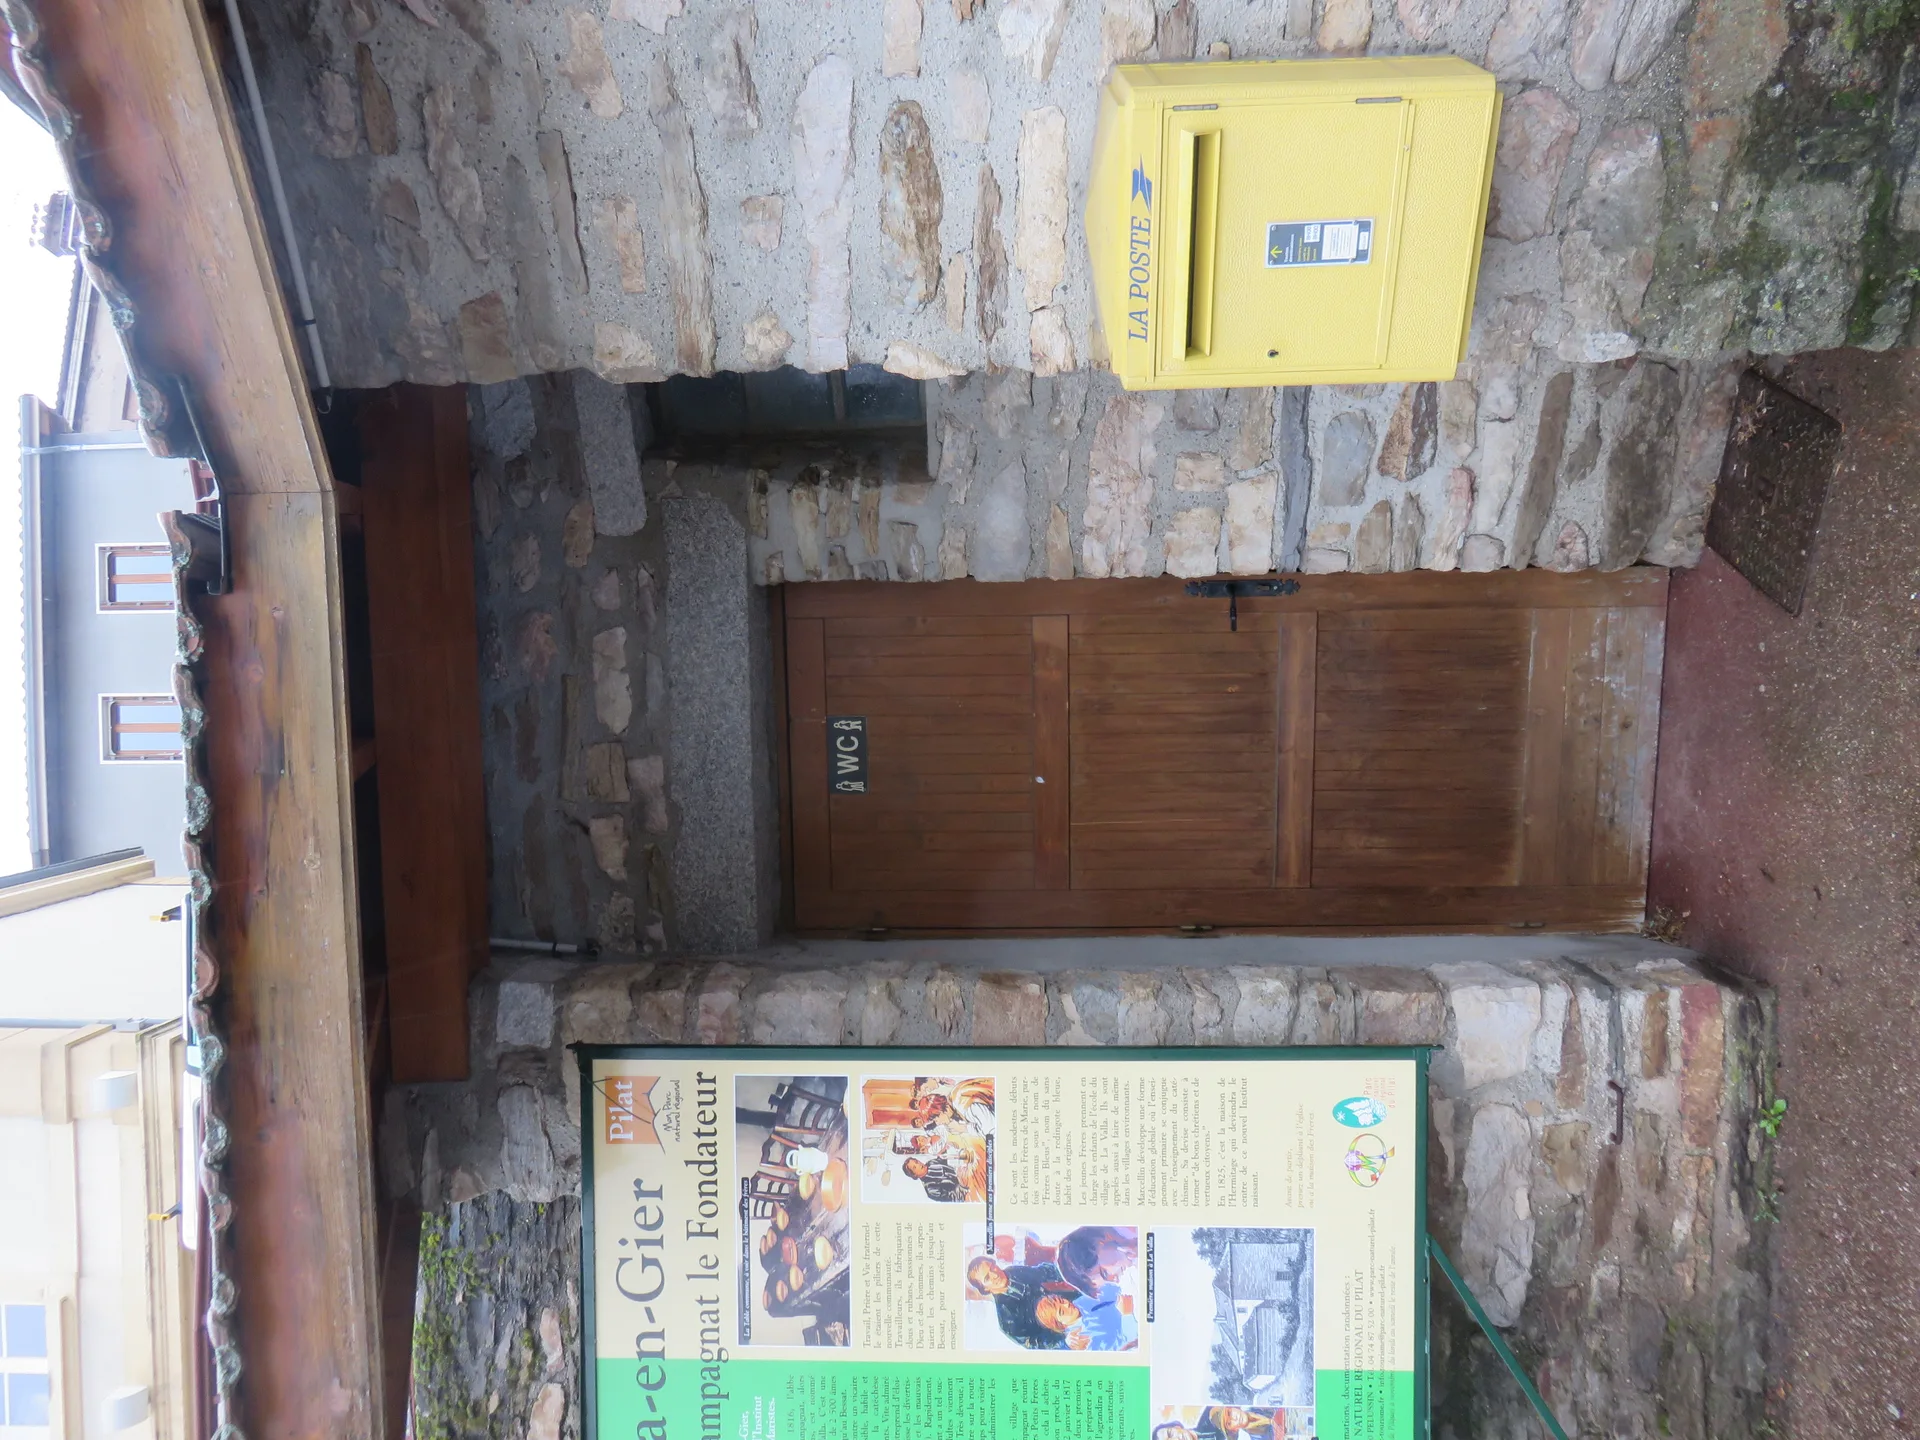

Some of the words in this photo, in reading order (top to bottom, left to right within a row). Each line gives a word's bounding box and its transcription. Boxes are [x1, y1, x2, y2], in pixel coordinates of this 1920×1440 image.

[1129, 216, 1151, 301] POSTE
[1128, 308, 1149, 343] LA
[837, 736, 859, 774] WC
[662, 1091, 672, 1110] Parc
[670, 1080, 683, 1110] régional
[1009, 1076, 1017, 1103] débuts
[1053, 1077, 1061, 1102] bleue,
[1089, 1091, 1097, 1117] l'école
[1137, 1077, 1145, 1101] forme
[1148, 1077, 1156, 1107] l'ensei-
[1160, 1077, 1168, 1115] conjugue
[1239, 1078, 1247, 1108] Institut
[609, 1080, 633, 1141] Pilat
[1020, 1096, 1029, 1122] Marie,
[1080, 1091, 1088, 1128] prennent
[1181, 1088, 1189, 1121] consiste
[1191, 1100, 1199, 1138] chrétiens
[1228, 1092, 1236, 1132] deviendra
[663, 1113, 672, 1131] Mon
[670, 1112, 680, 1142] naturel
[1053, 1110, 1062, 1149] redingote
[1100, 1118, 1108, 1141] Valla.
[1111, 1120, 1119, 1138] faire
[1239, 1116, 1247, 1144] nouvel
[684, 1071, 719, 1240] Fondateur
[1020, 1138, 1028, 1163] Frères
[1042, 1139, 1050, 1169] Bleus”,
[1065, 1131, 1073, 1166] origines.
[1079, 1132, 1087, 1157] Frères
[1122, 1141, 1131, 1170] villages
[1137, 1123, 1147, 1164] développe
[1148, 1126, 1157, 1155] globale
[1160, 1132, 1168, 1167] primaire
[1169, 1121, 1179, 1182] l'enseignement
[1181, 1128, 1189, 1153] devise
[1202, 1125, 1212, 1167] citoyens.”
[1020, 1166, 1028, 1189] Petits
[1042, 1175, 1050, 1205] “Frères
[1079, 1162, 1088, 1188] jeunes
[1137, 1167, 1145, 1206] Marcellin
[1148, 1159, 1156, 1206] d'éducation
[1160, 1172, 1168, 1206] gnement
[1228, 1158, 1238, 1207] l'Hermitage
[1053, 1182, 1061, 1205] doute
[1064, 1185, 1072, 1205] habit
[1090, 1179, 1099, 1206] charge
[1100, 1180, 1109, 1206] village
[1111, 1177, 1120, 1206] appelés
[1181, 1176, 1189, 1207] chisme.
[1191, 1179, 1200, 1207] former
[862, 1222, 870, 1260] fraternel-
[894, 1222, 904, 1273] fabriquaient
[926, 1223, 935, 1259] jusqu'au
[686, 1254, 719, 1281] le
[862, 1263, 870, 1276] Vie
[906, 1236, 914, 1278] passionnés
[937, 1240, 945, 1282] catéchiser
[873, 1262, 882, 1286] piliers
[884, 1257, 892, 1311] communauté.
[916, 1264, 924, 1300] hommes,
[1355, 1270, 1363, 1300] PILAT
[906, 1283, 914, 1312] rubans,
[1342, 1282, 1350, 1331] randonnées
[1355, 1304, 1363, 1320] DU
[1368, 1308, 1374, 1317] 00
[863, 1317, 871, 1348] Travail,
[884, 1315, 892, 1348] nouvelle
[895, 1296, 903, 1348] Travailleurs,
[938, 1320, 946, 1349] Bessat,
[949, 1310, 957, 1349] enseigner.
[1368, 1320, 1374, 1328] 52
[1368, 1332, 1374, 1340] 87
[906, 1328, 914, 1349] clous
[916, 1330, 924, 1349] Dieu
[1368, 1344, 1374, 1352] 74
[1342, 1336, 1350, 1399] documentation
[1368, 1356, 1374, 1365] 04
[1354, 1384, 1363, 1436] NATUREL
